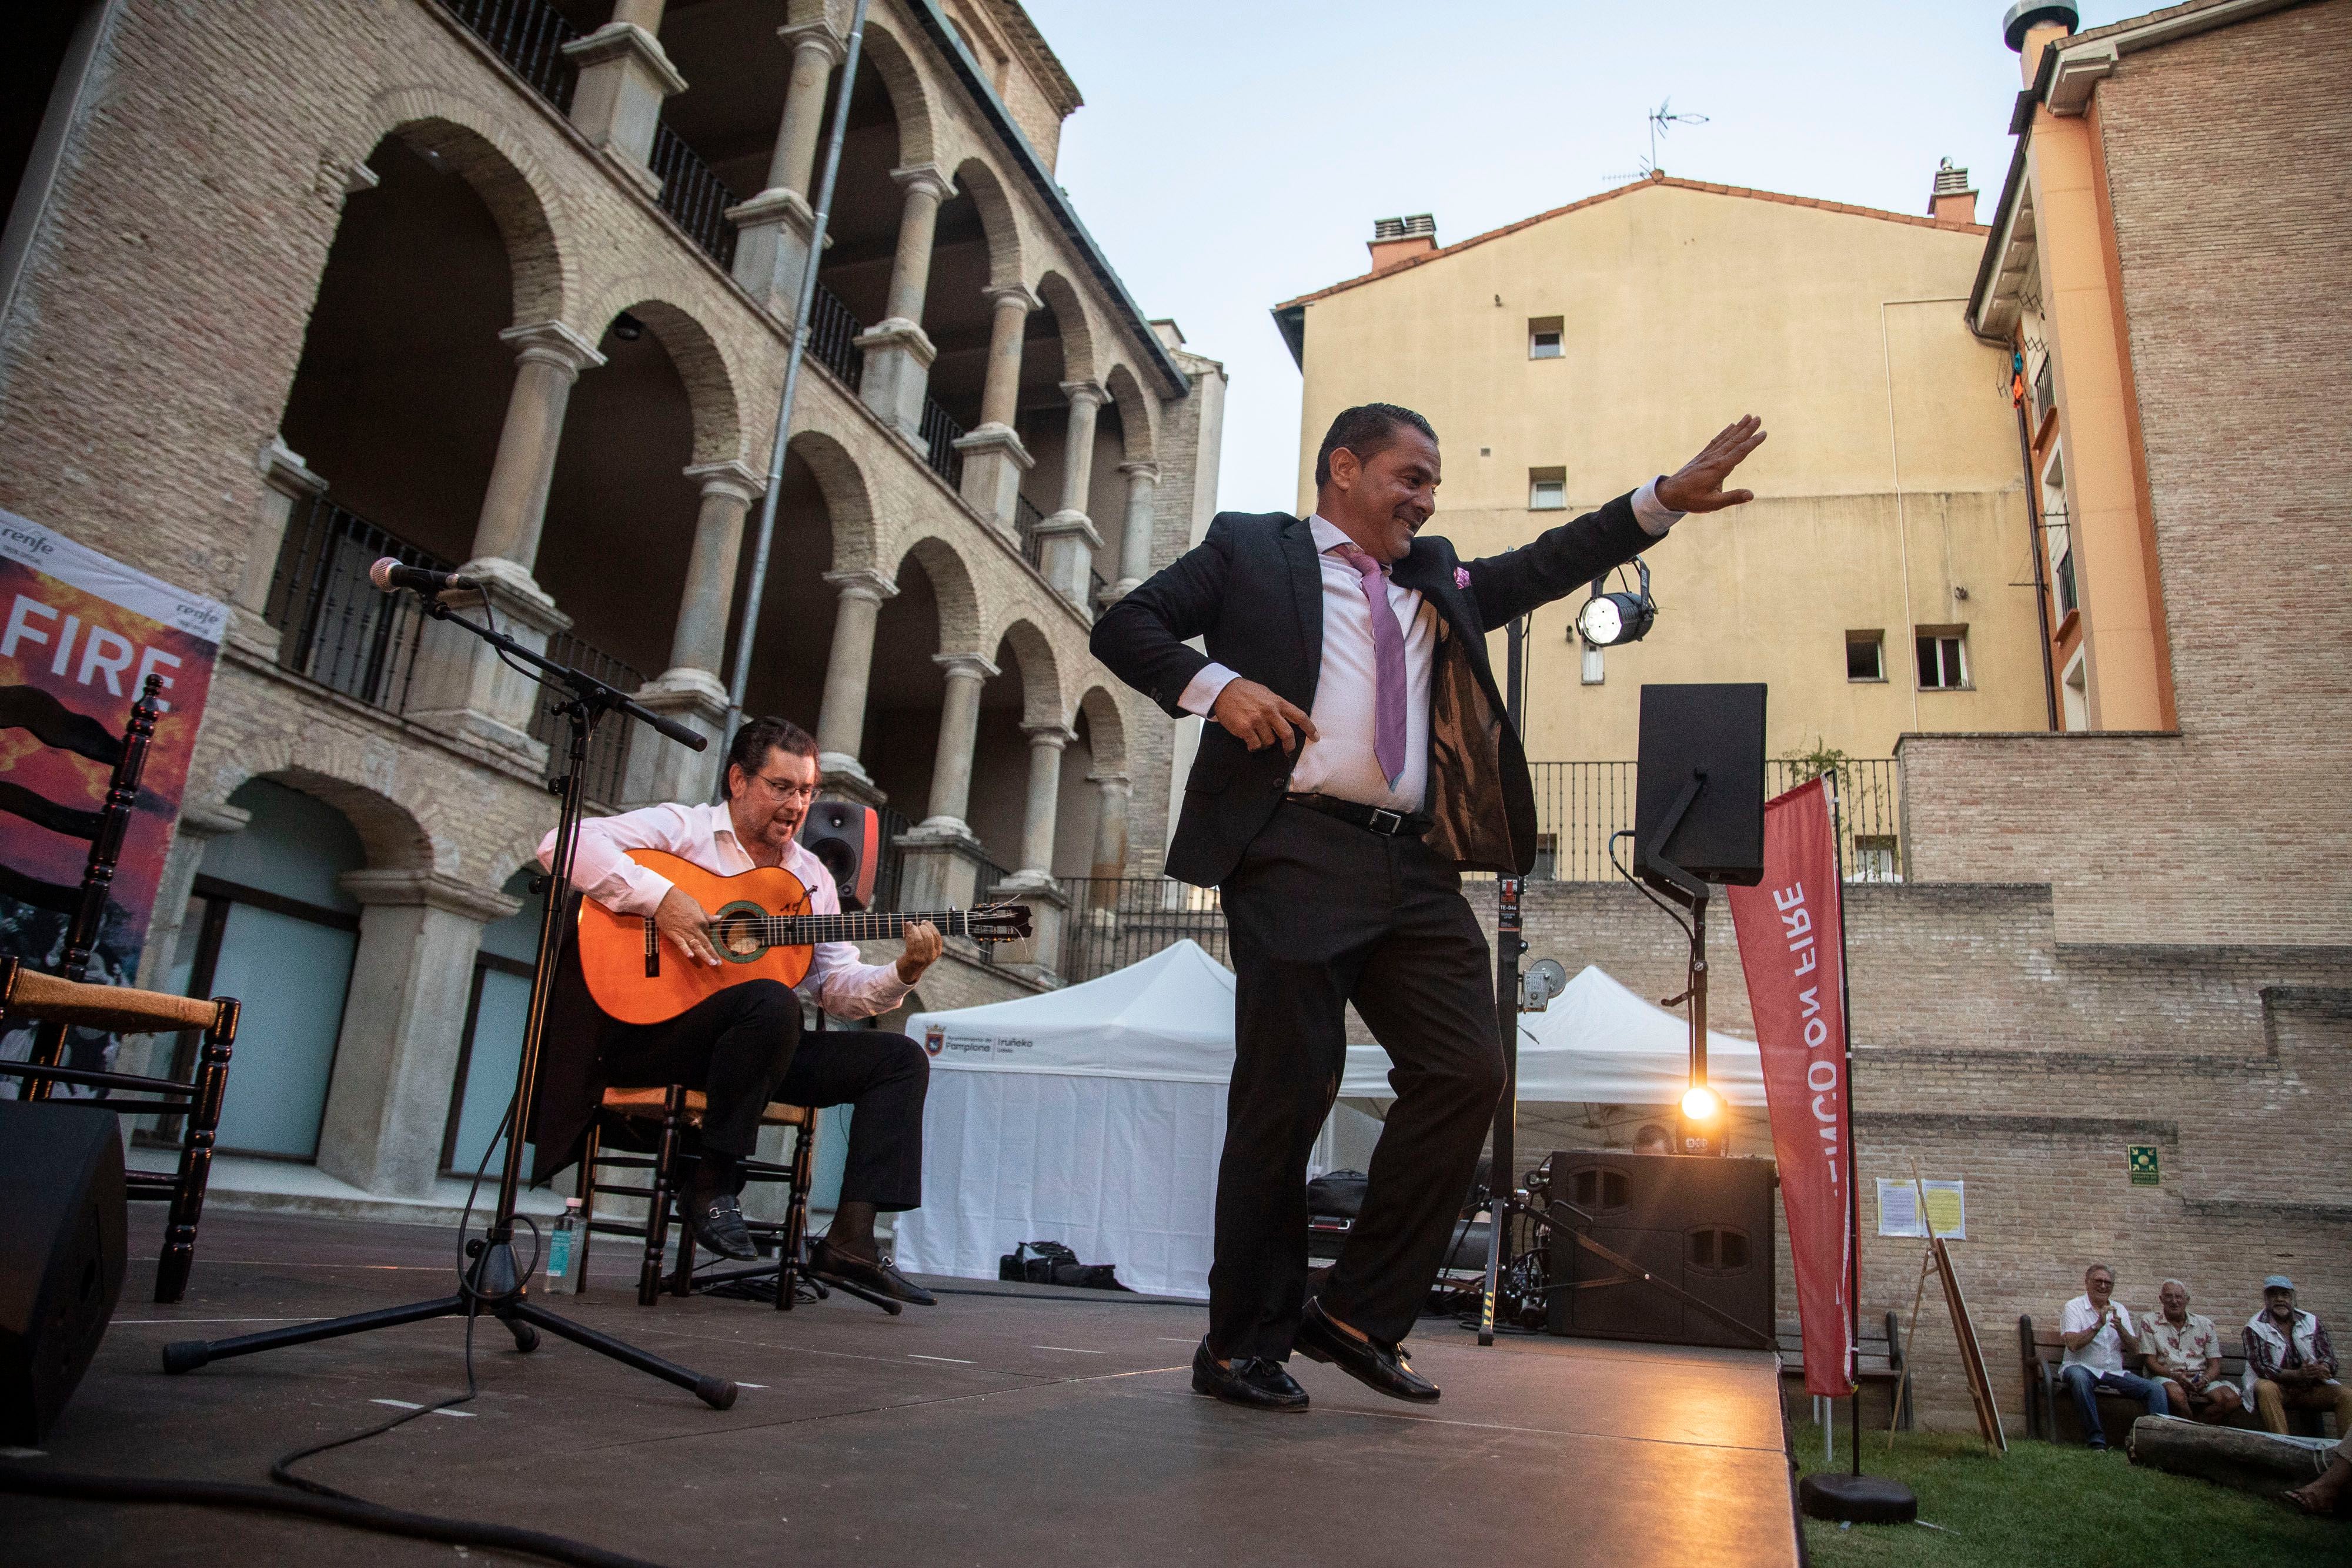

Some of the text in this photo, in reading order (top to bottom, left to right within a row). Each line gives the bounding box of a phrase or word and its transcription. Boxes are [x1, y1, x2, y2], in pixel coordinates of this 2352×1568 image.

[2, 529, 54, 554] renfe
[176, 603, 220, 624] renfe
[1, 594, 182, 713] FIRE
[946, 1042, 991, 1053] Pamplona
[998, 1038, 1034, 1048] Iruñeko
